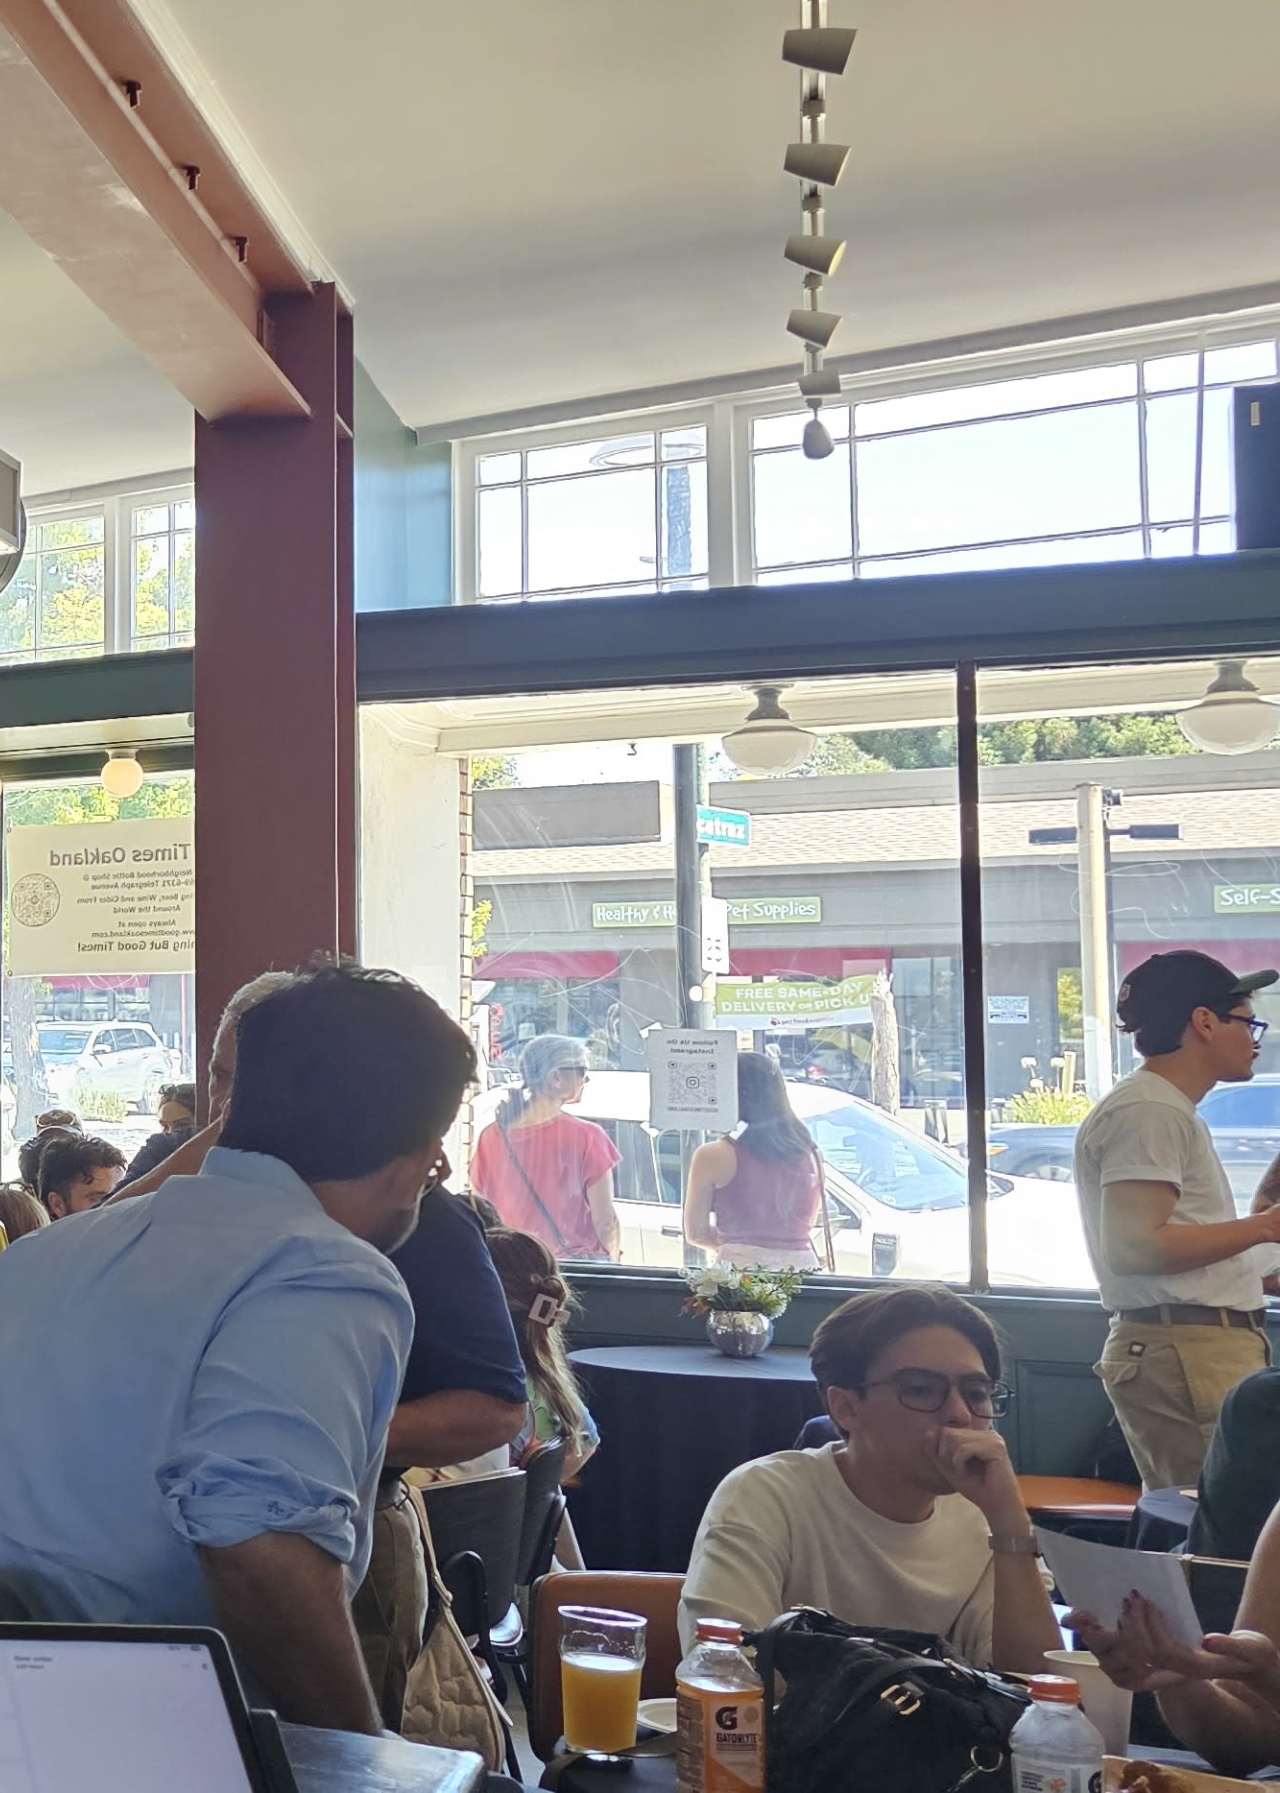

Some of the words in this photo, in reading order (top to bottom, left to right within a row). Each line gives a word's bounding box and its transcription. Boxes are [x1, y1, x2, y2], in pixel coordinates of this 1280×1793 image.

[596, 904, 649, 924] Healthy
[752, 901, 817, 922] Supplies
[736, 988, 774, 1000] FREE
[779, 981, 866, 999] SAME-DAY
[721, 1001, 796, 1013] DELIVERY
[814, 997, 851, 1011] PICK
[715, 1706, 738, 1730] G
